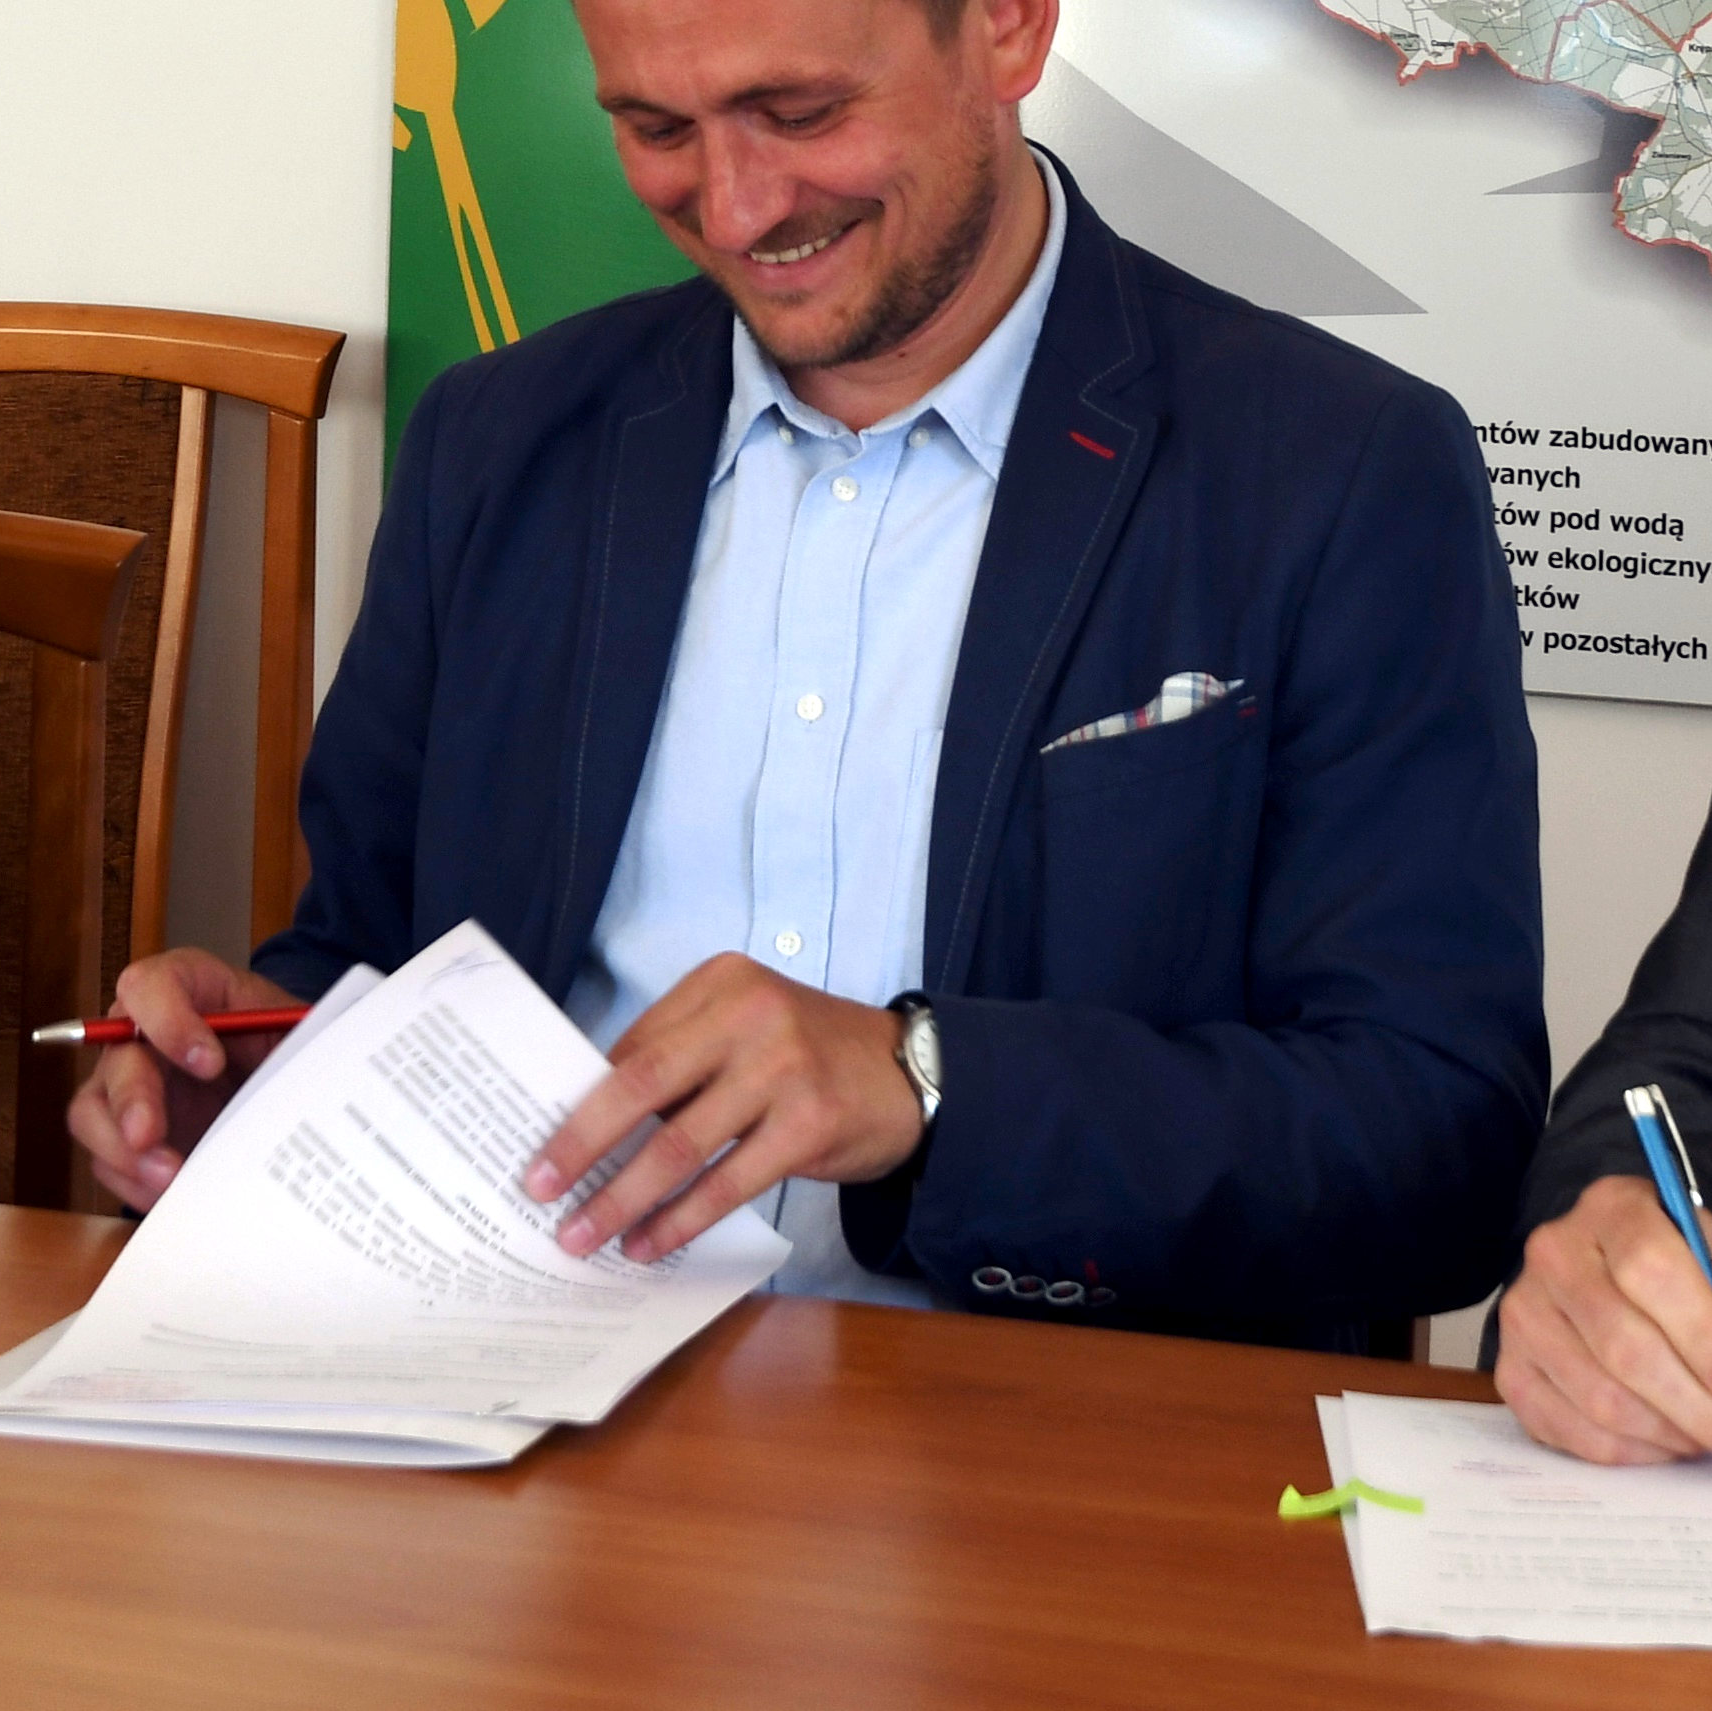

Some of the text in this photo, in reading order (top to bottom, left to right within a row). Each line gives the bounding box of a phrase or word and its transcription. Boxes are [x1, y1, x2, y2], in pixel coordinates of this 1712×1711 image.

[1474, 421, 1539, 445] ntów
[1487, 466, 1580, 491] wanych
[1550, 508, 1600, 534] pod
[1609, 512, 1684, 542] wodą
[1515, 585, 1579, 609] tków
[1543, 631, 1708, 663] pozostałych
